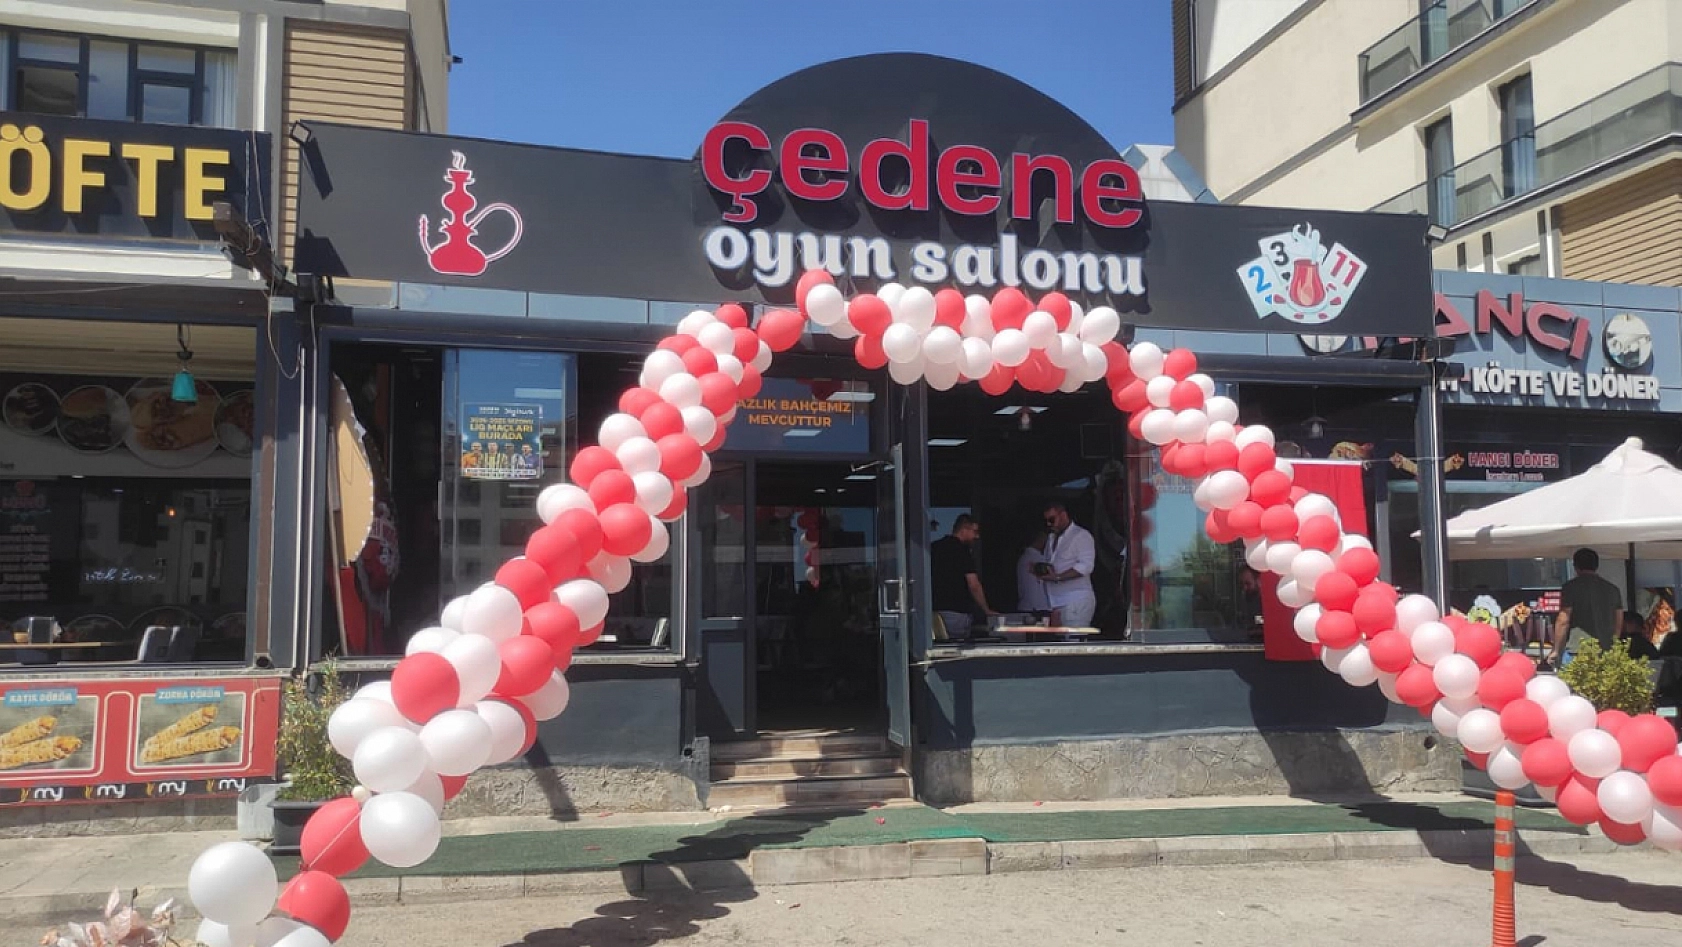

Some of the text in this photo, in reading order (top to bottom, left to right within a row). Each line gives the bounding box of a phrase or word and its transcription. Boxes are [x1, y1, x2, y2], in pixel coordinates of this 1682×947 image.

[0, 124, 230, 220] ÖFTE
[701, 118, 1144, 229] çedene
[704, 226, 1146, 295] oyun salonu
[1270, 241, 1289, 266] 3
[1248, 265, 1272, 294] 2
[1362, 289, 1591, 360] ANCI
[1471, 361, 1661, 400] KÖFTE VE DÖNER
[736, 398, 852, 414] AZLIK BAHÇEMİZ
[749, 413, 832, 427] MEVCUTTUR
[478, 431, 523, 440] BURADA
[1513, 450, 1559, 468] DÖNER
